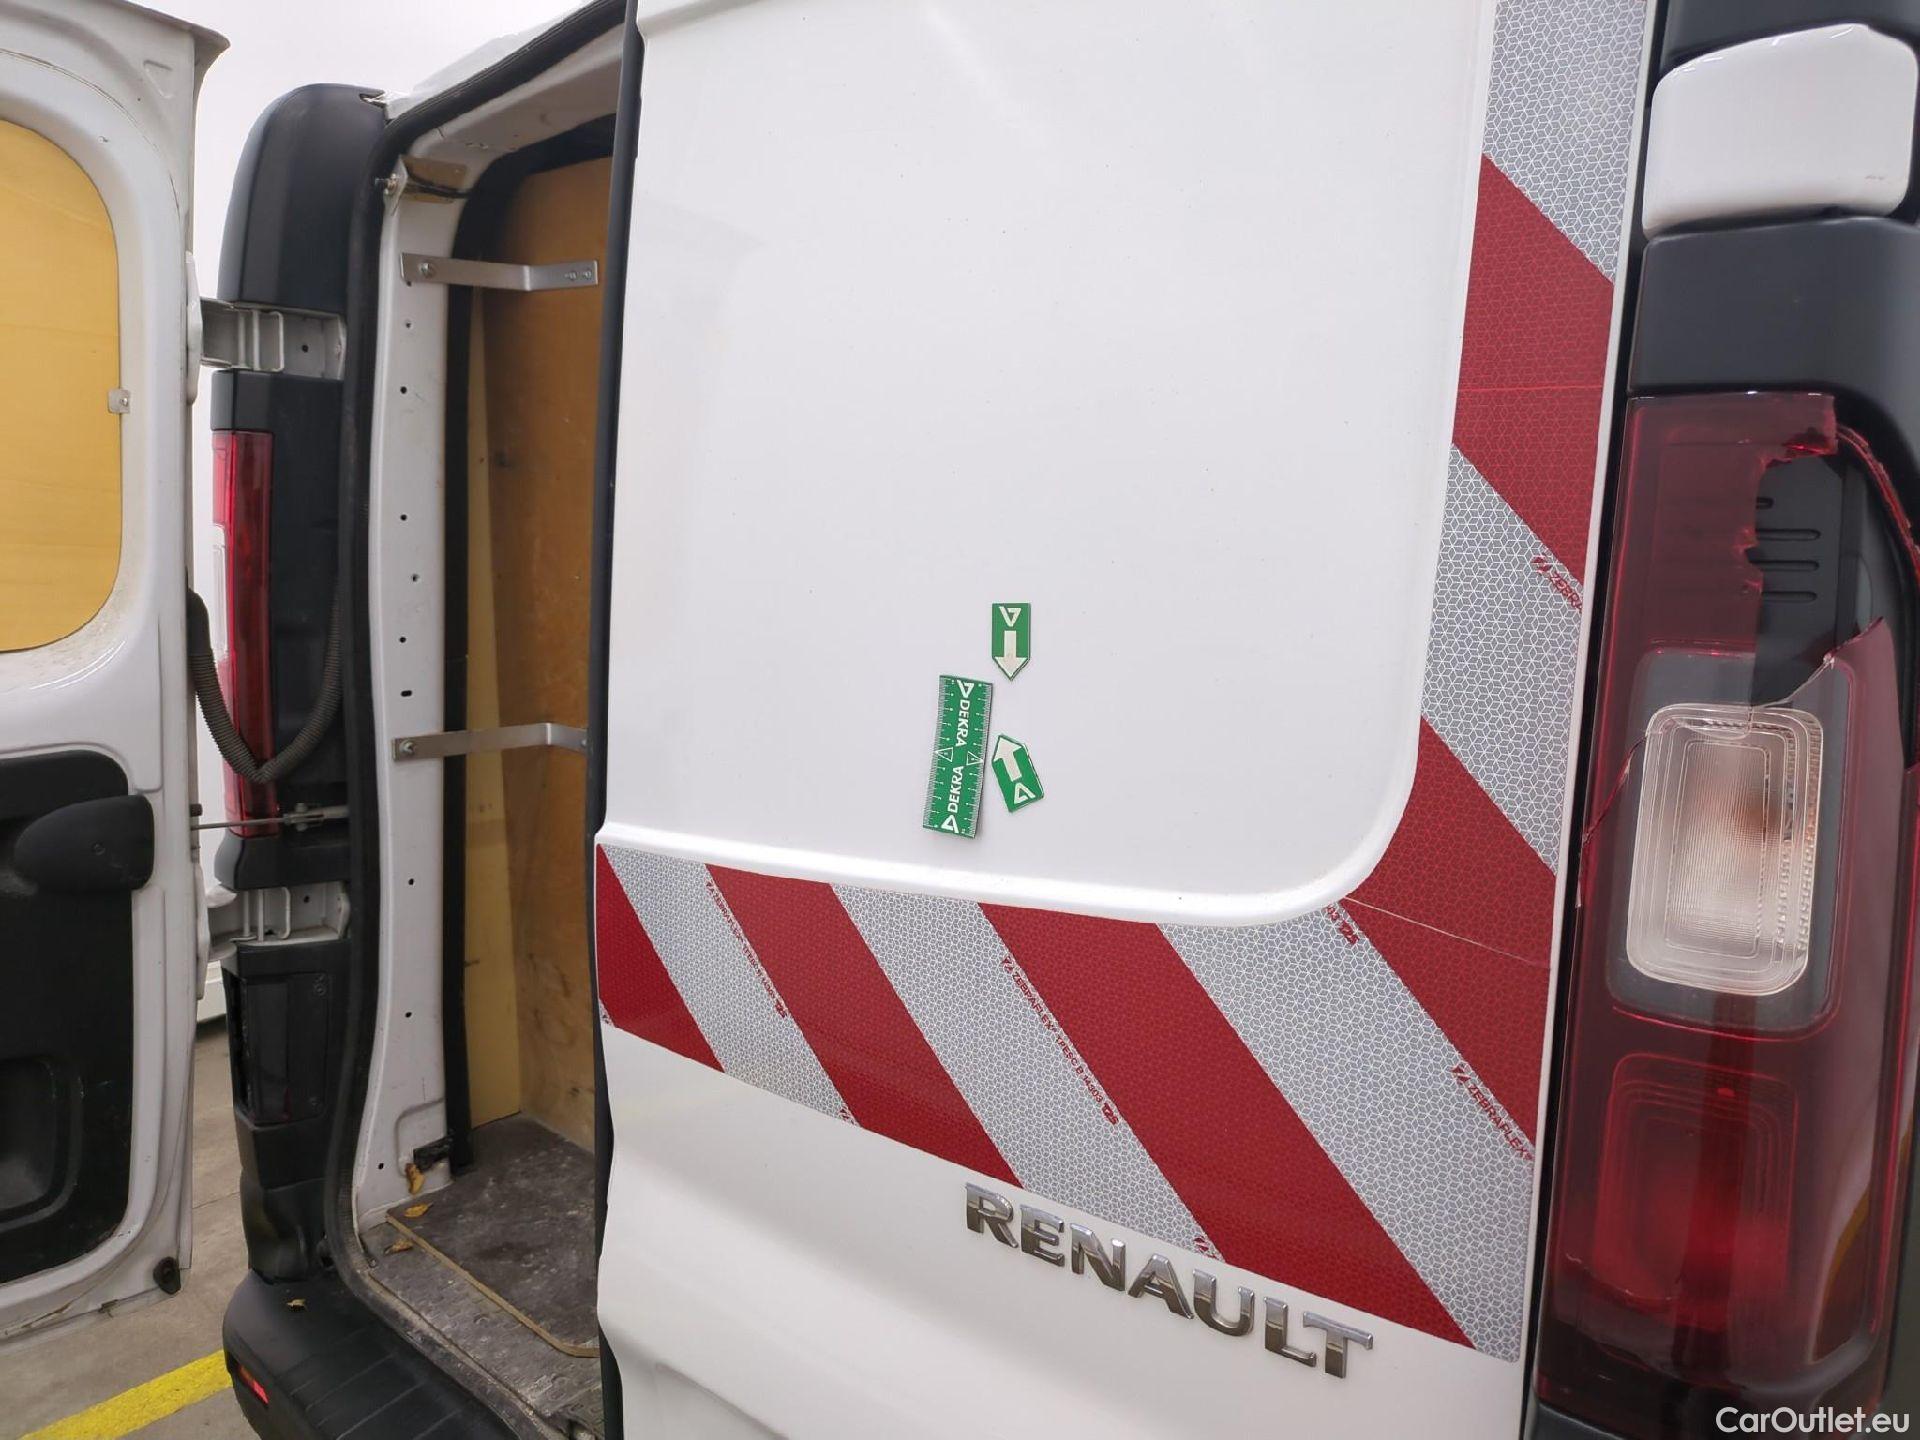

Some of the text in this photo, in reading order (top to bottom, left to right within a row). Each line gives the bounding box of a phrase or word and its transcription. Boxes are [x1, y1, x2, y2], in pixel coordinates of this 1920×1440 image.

[955, 699, 971, 747] DEKRA
[947, 766, 964, 813] DEKRA
[964, 1182, 1374, 1379] RENAULT
